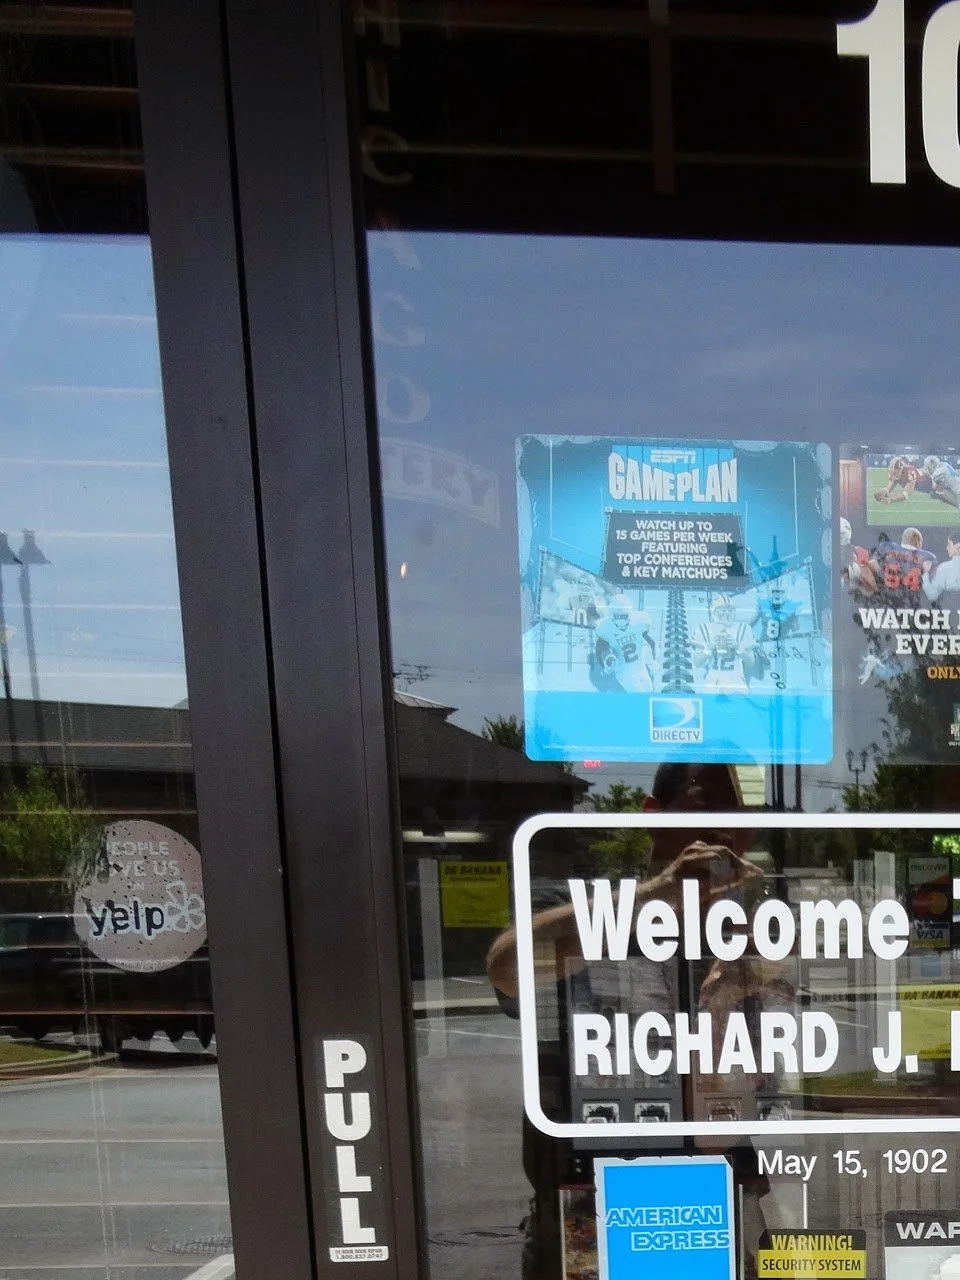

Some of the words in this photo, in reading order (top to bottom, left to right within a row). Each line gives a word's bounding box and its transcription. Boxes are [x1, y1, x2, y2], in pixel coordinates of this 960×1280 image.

[650, 449, 697, 464] ESPN
[635, 519, 676, 531] WATCH
[679, 520, 694, 531] UP
[697, 521, 713, 531] TO
[616, 530, 628, 540] 15
[630, 530, 671, 541] GAMES
[673, 531, 695, 542] PER
[698, 532, 733, 544] WEEK
[641, 542, 708, 554] FEATURING
[616, 553, 642, 564] TOP
[644, 554, 733, 567] CONFERENCES
[621, 566, 631, 577] &
[633, 566, 658, 578] KEY
[662, 567, 728, 579] MATCHUPS
[858, 608, 951, 630] WATCH
[652, 730, 700, 741] DIRECTV
[153, 860, 181, 876] US
[91, 900, 165, 937] yelp
[568, 878, 910, 963] Welcome
[573, 1011, 840, 1077] RICHARD
[872, 1011, 919, 1074] J.
[323, 1039, 377, 1244] PULL
[757, 1149, 818, 1181] May
[832, 1150, 868, 1179] 15,
[882, 1148, 949, 1174] 1902
[606, 1205, 723, 1227] AMERICAN
[631, 1230, 730, 1252] EXPRESS
[771, 1233, 853, 1251] WARNING!
[761, 1257, 816, 1272] SECURITY
[818, 1257, 862, 1271] SYSTEM
